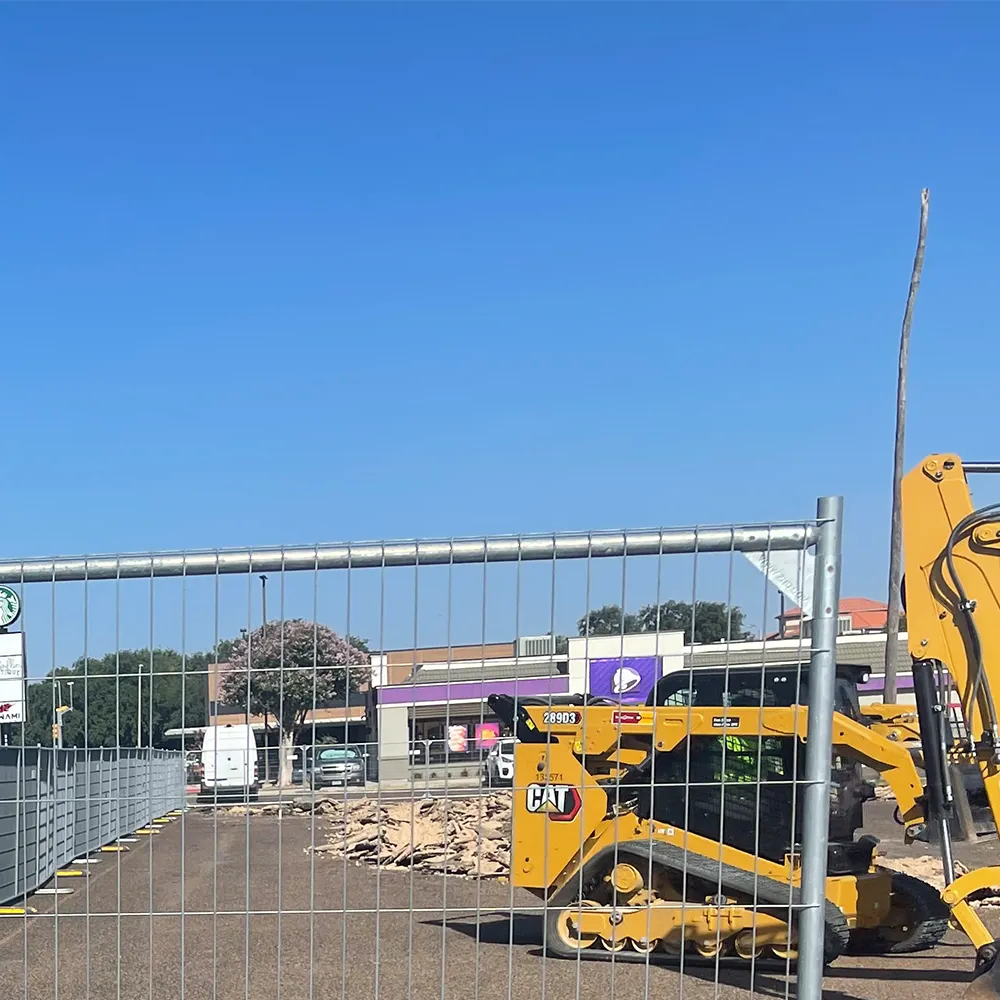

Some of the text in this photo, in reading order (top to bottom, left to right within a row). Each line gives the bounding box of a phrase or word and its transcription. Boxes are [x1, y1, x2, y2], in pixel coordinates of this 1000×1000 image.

[543, 712, 576, 724] 289D3
[536, 773, 563, 781] 13571
[527, 784, 569, 813] CAT
